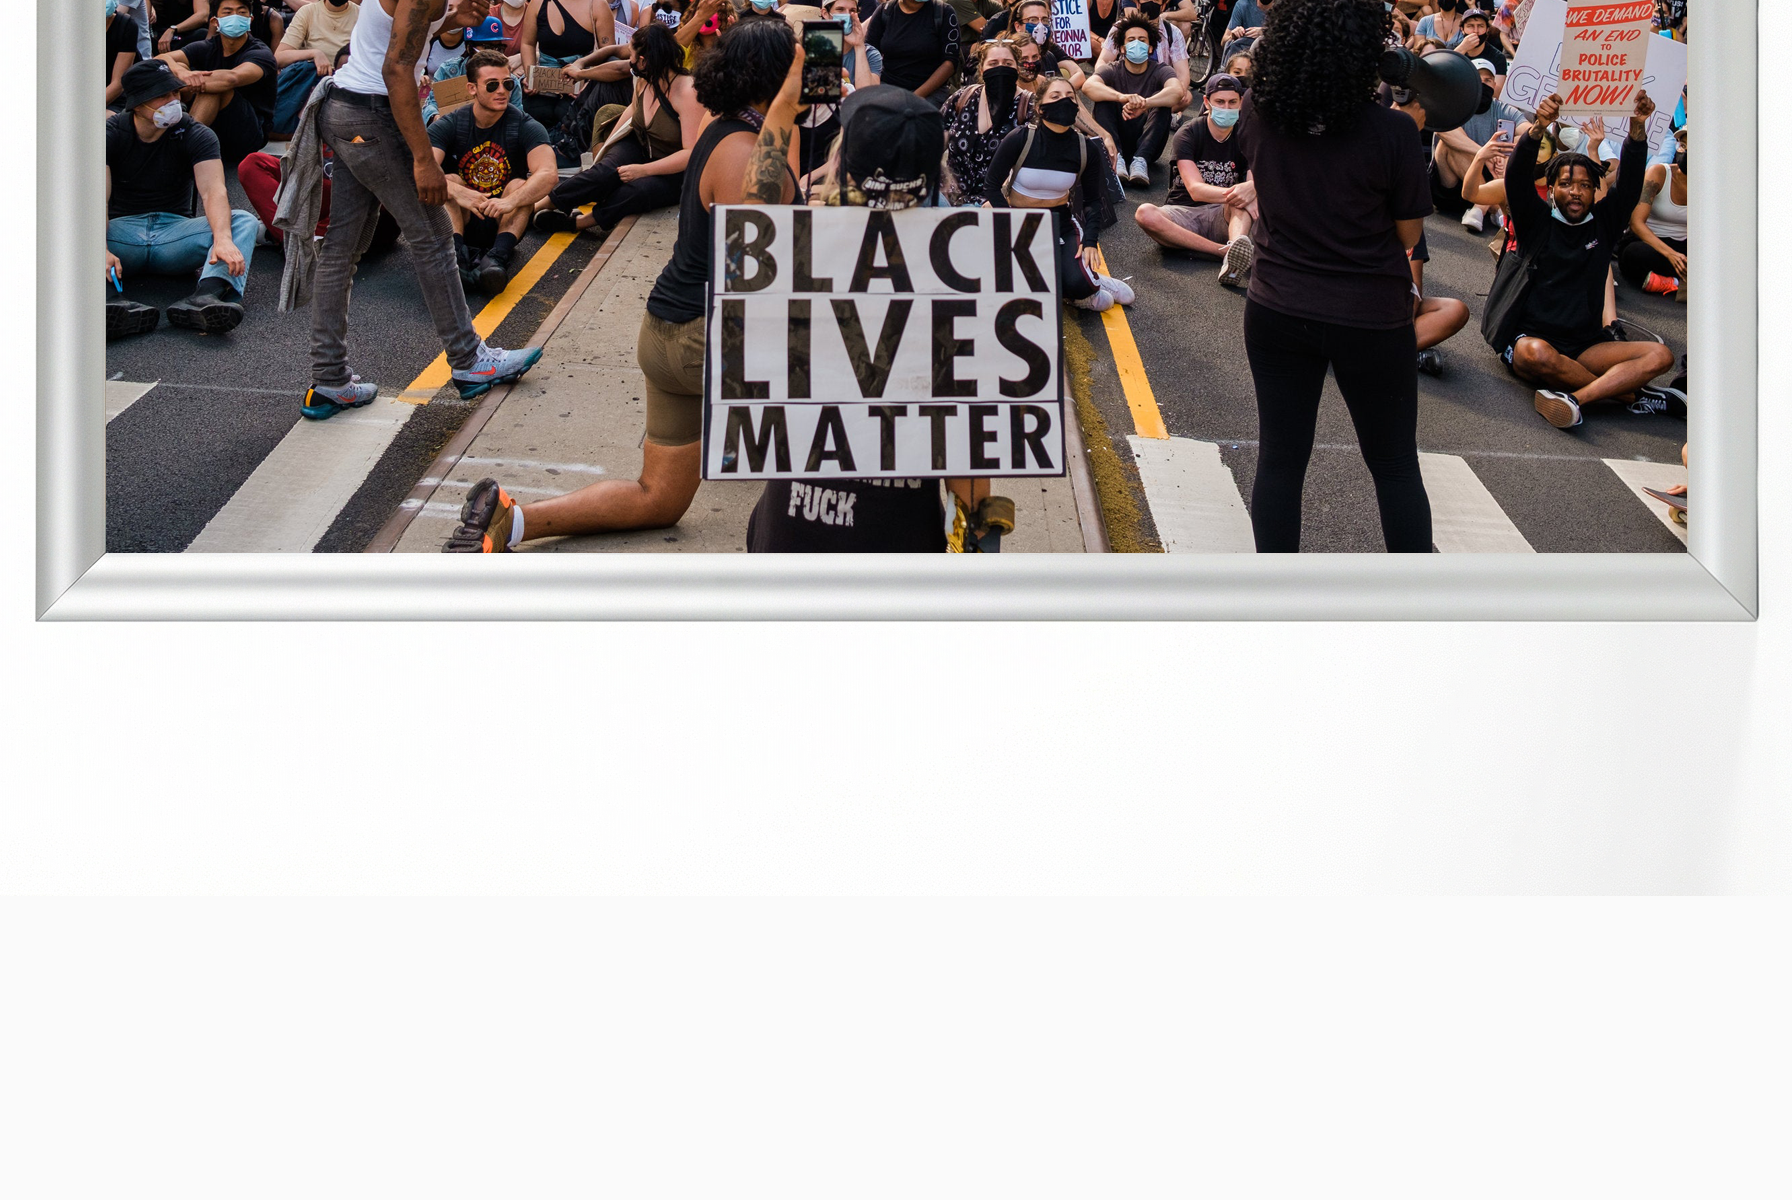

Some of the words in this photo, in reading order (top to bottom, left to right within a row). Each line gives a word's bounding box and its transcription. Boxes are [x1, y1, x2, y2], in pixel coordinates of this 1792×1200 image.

[1055, 16, 1071, 29] FOR
[1567, 10, 1592, 24] WE
[1593, 3, 1653, 23] DEMAND
[1574, 29, 1604, 41] AN
[1604, 29, 1642, 42] END
[1578, 53, 1628, 66] POLICE
[533, 68, 556, 78] BLACK
[1562, 68, 1643, 82] BRUTALITY
[1565, 84, 1634, 105] NOW!
[724, 209, 1051, 294] BLACK
[720, 297, 1051, 400] LIVES
[720, 404, 1055, 473] MATTER
[787, 481, 857, 527] FUCK
